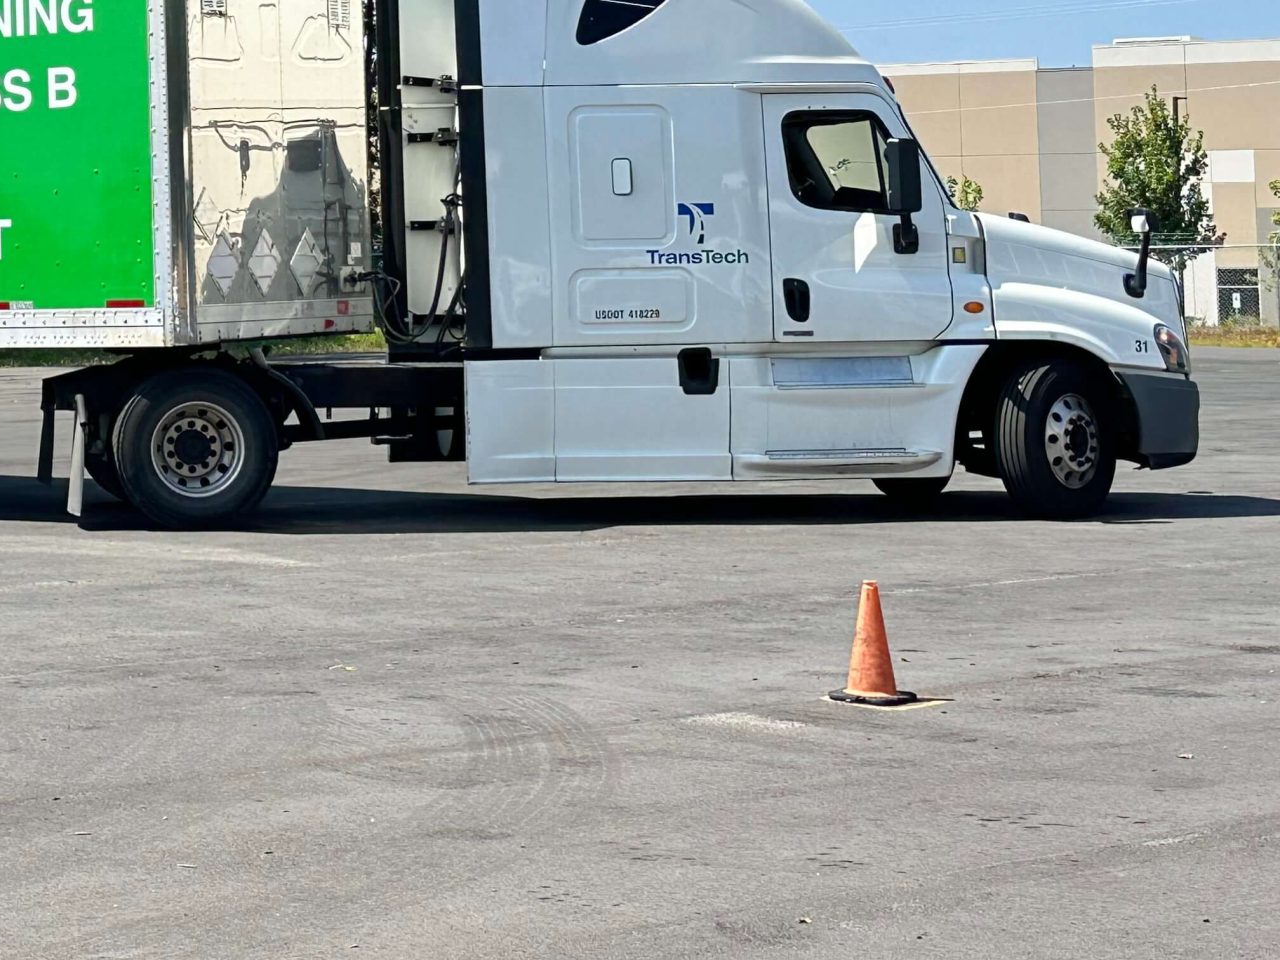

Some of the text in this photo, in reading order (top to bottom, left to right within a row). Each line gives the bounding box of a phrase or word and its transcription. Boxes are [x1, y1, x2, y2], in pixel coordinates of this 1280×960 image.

[47, 66, 78, 109] B
[646, 248, 750, 266] TransTech
[1135, 339, 1148, 353] 31
